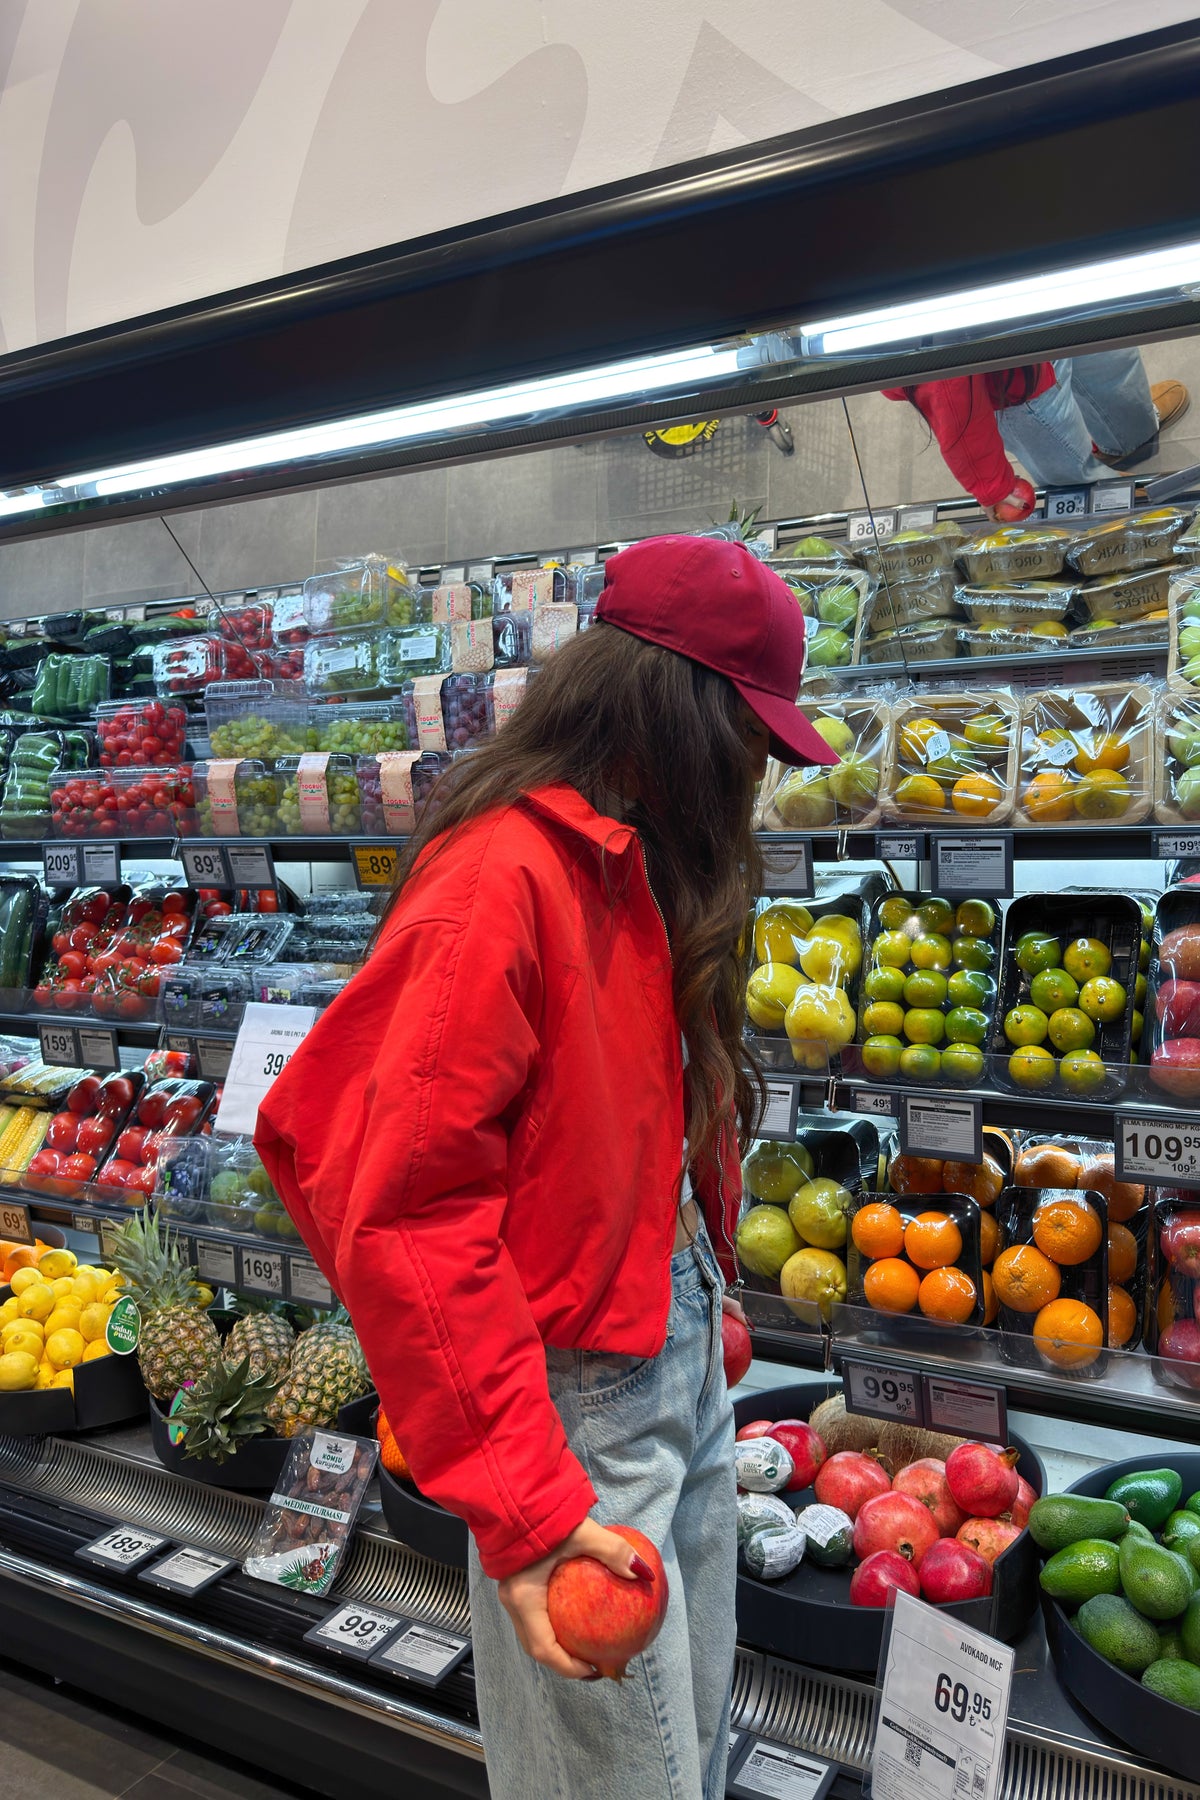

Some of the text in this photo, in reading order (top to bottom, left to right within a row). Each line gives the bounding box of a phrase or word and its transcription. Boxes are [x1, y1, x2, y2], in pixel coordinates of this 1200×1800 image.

[1142, 1121, 1174, 1129] STARKING
[1175, 1123, 1189, 1131] MCF
[960, 1641, 1004, 1671] AVOKADO MCF
